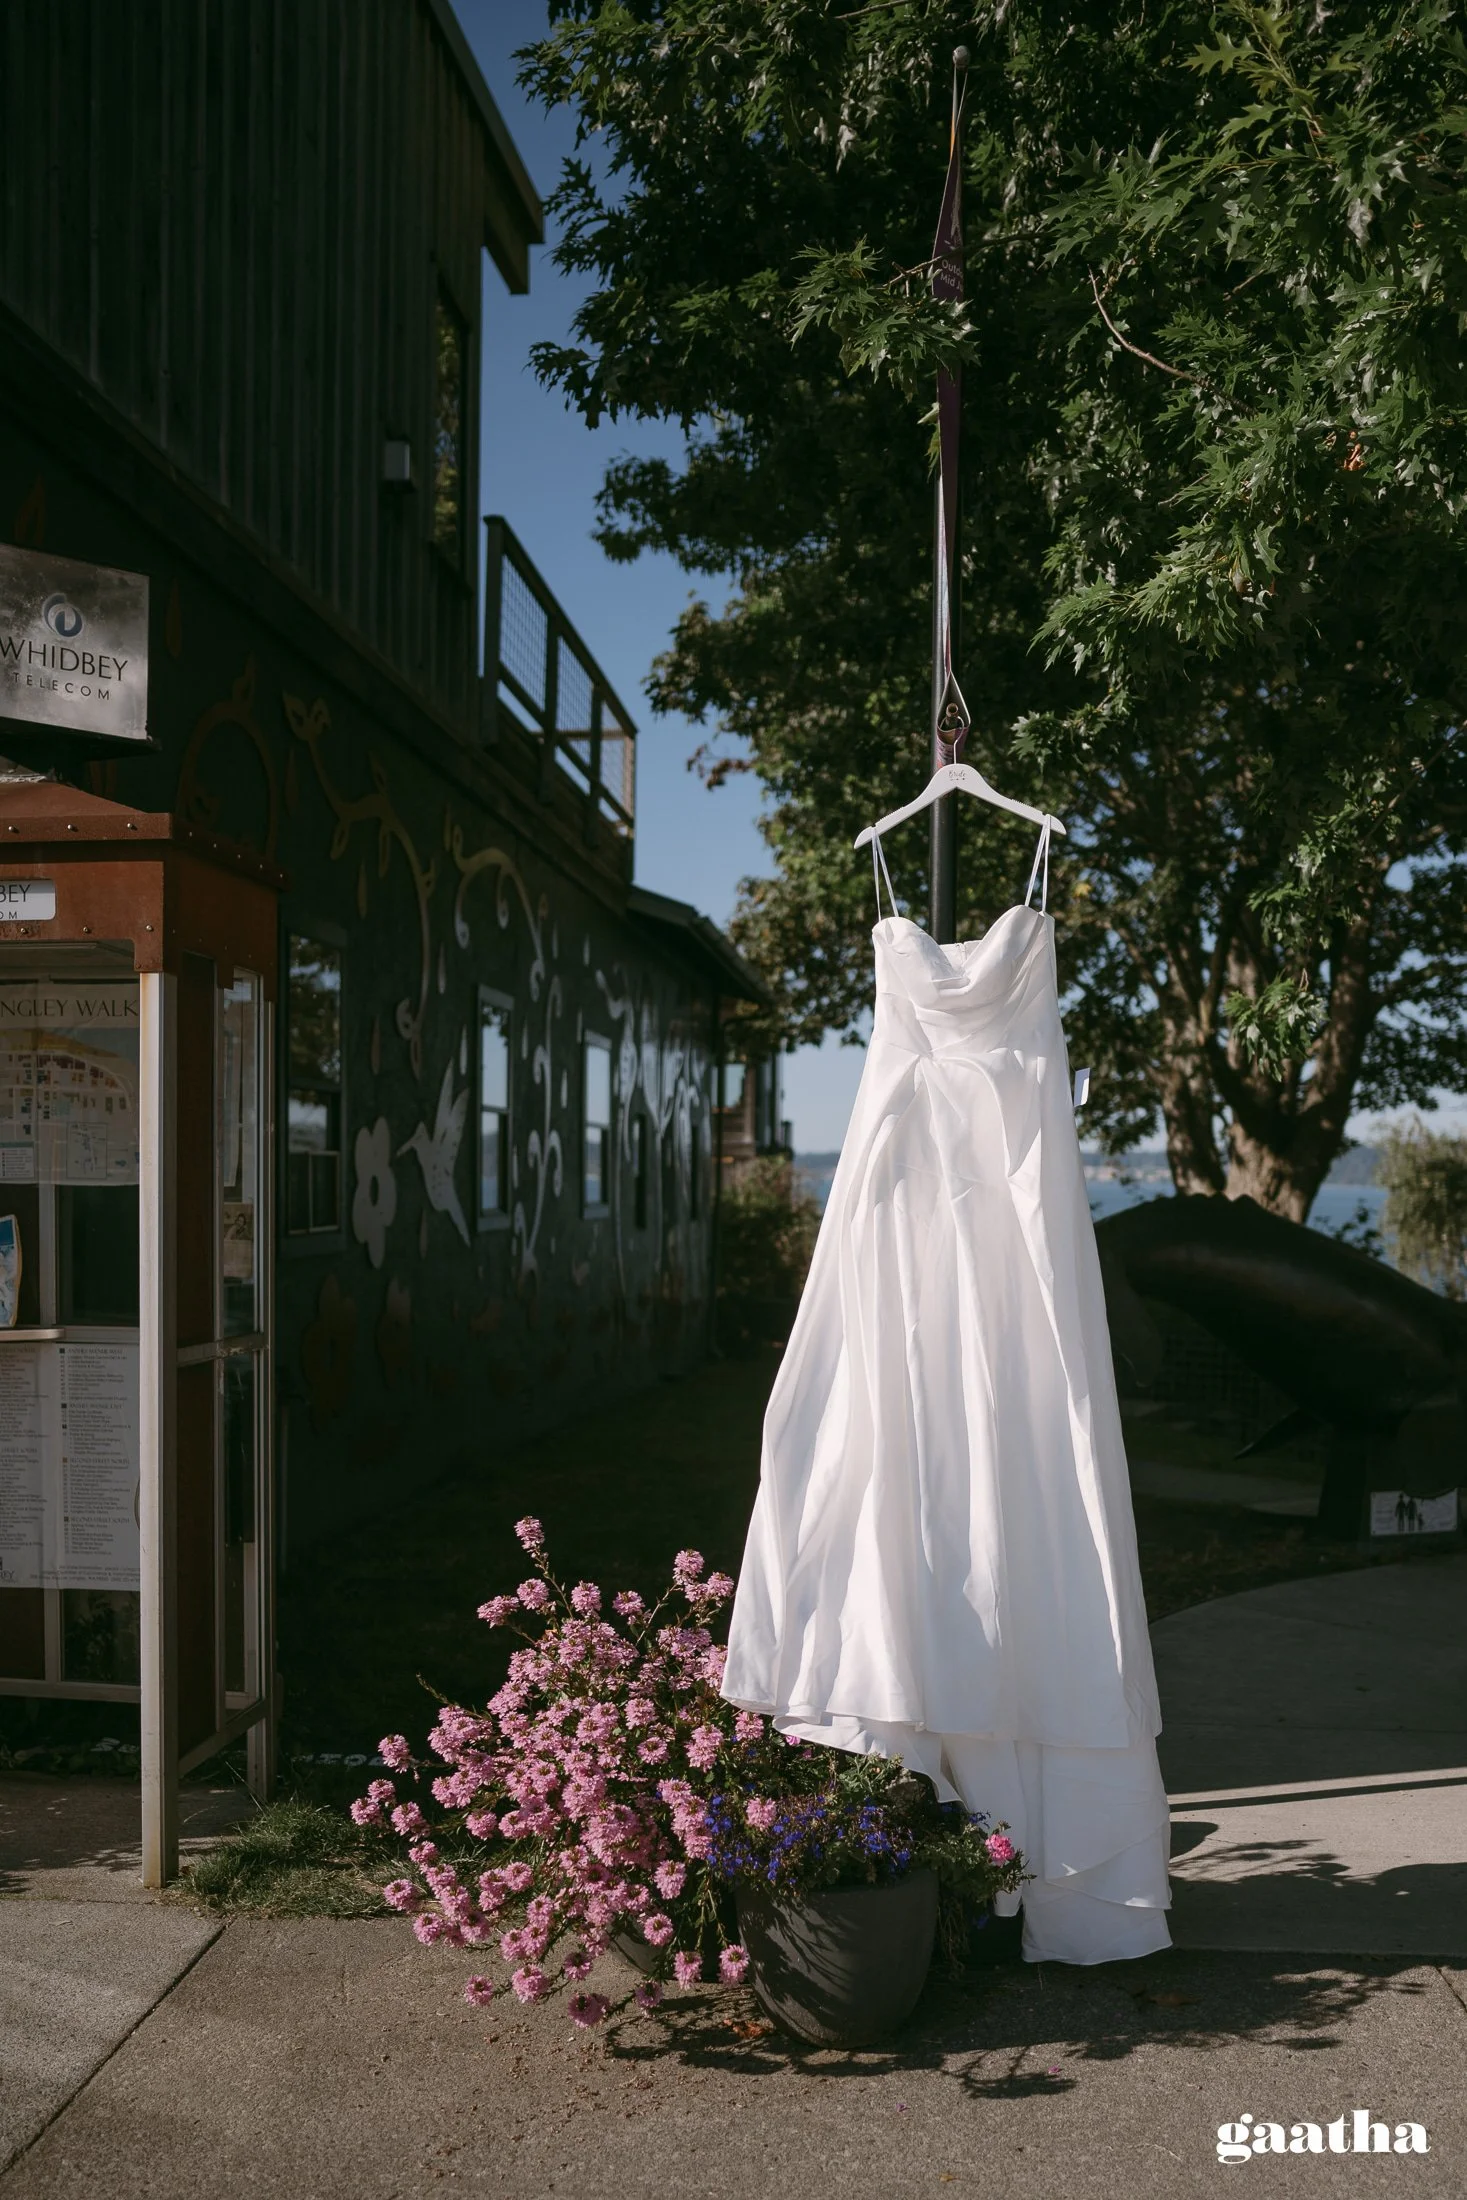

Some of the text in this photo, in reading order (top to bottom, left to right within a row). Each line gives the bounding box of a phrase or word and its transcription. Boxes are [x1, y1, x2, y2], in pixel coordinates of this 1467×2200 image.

[940, 272, 956, 287] Mid
[0, 636, 129, 681] WHIDBEY
[13, 672, 110, 700] TELECOM
[75, 999, 139, 1018] WALK
